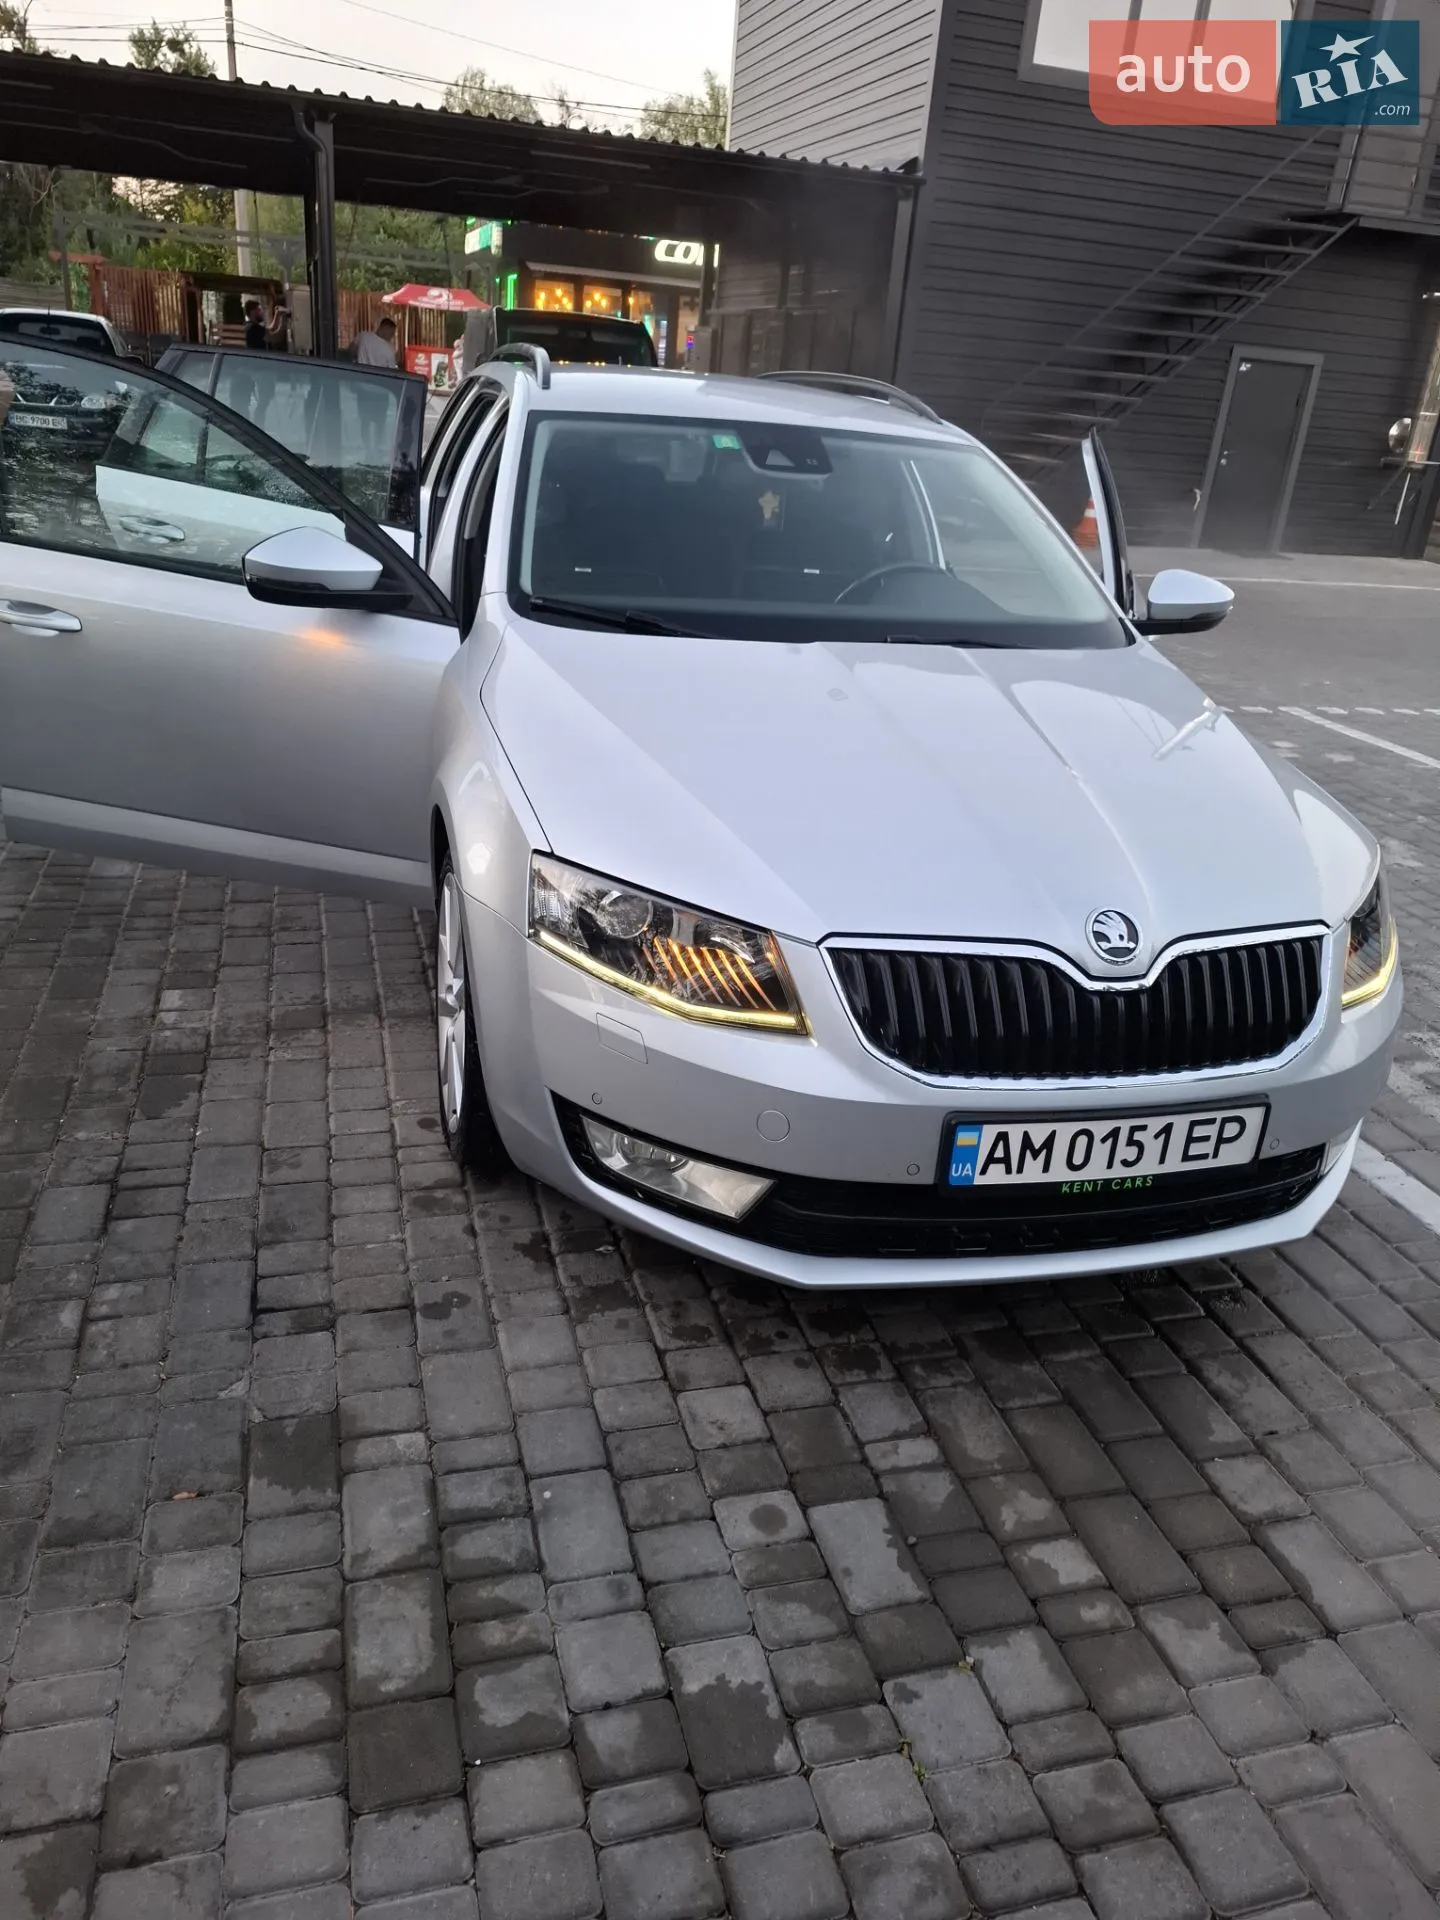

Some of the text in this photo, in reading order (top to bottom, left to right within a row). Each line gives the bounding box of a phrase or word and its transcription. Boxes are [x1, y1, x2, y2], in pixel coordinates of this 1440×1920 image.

[979, 1115, 1247, 1176] AM 0151 EP
[951, 1165, 973, 1179] UA
[1061, 1176, 1154, 1194] KENT CARS
